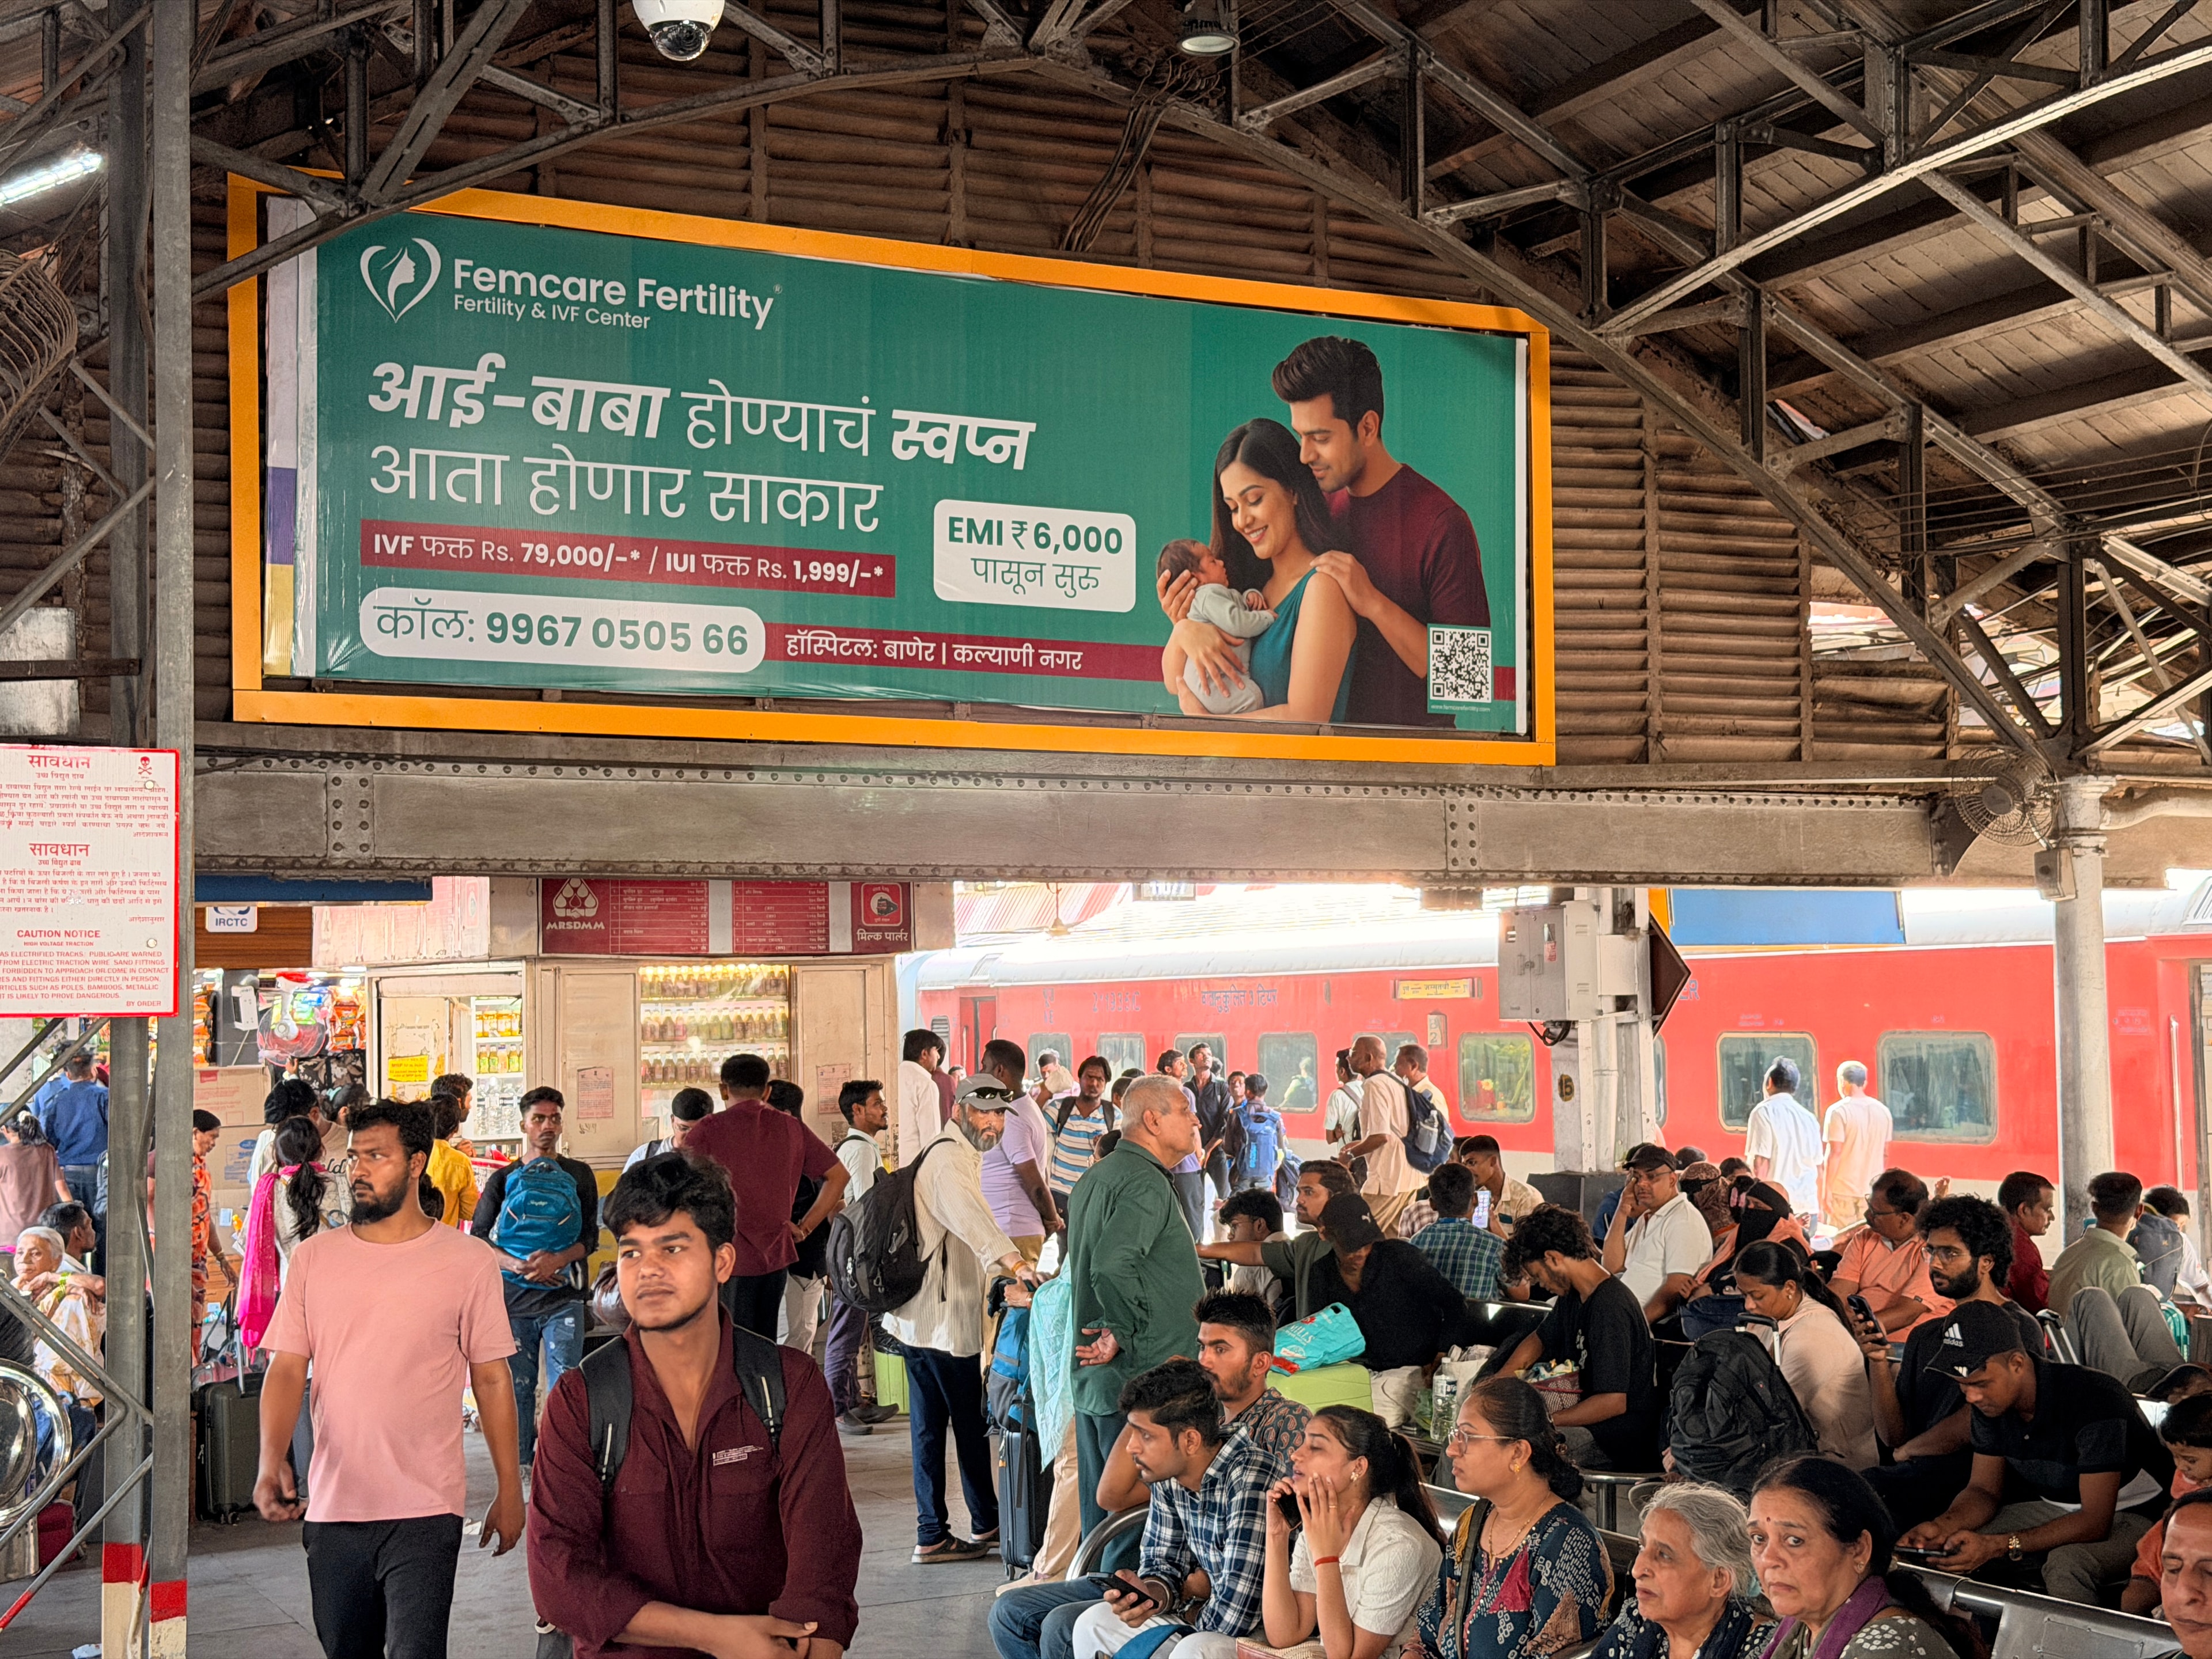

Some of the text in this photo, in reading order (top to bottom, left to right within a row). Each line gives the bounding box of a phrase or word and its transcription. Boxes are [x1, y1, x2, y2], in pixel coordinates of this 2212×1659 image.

[455, 259, 626, 305] Femcare
[454, 294, 650, 329] Fertility & IVF Center
[681, 378, 876, 457] होण्याचं
[892, 409, 1037, 471] स्वप्न
[370, 443, 884, 533] आता होणार साकार
[949, 516, 1003, 547] EMI
[374, 534, 414, 555] IVF
[420, 536, 475, 559] फक्त
[482, 541, 514, 562] Rs.
[666, 552, 695, 573] IUI
[701, 554, 752, 576] फक्त
[757, 559, 787, 579] Rs.
[970, 558, 1047, 596] पासून
[486, 612, 582, 647] 9967
[882, 635, 937, 662] बाणेर
[952, 642, 1035, 668] कल्याणी
[1039, 649, 1084, 671] नगर
[27, 755, 90, 768] सावधान
[29, 843, 90, 857] सावधान
[17, 930, 101, 938] CAUTION NOTICE
[215, 918, 248, 927] IRCTC
[856, 928, 909, 942] मिल्क पार्लर
